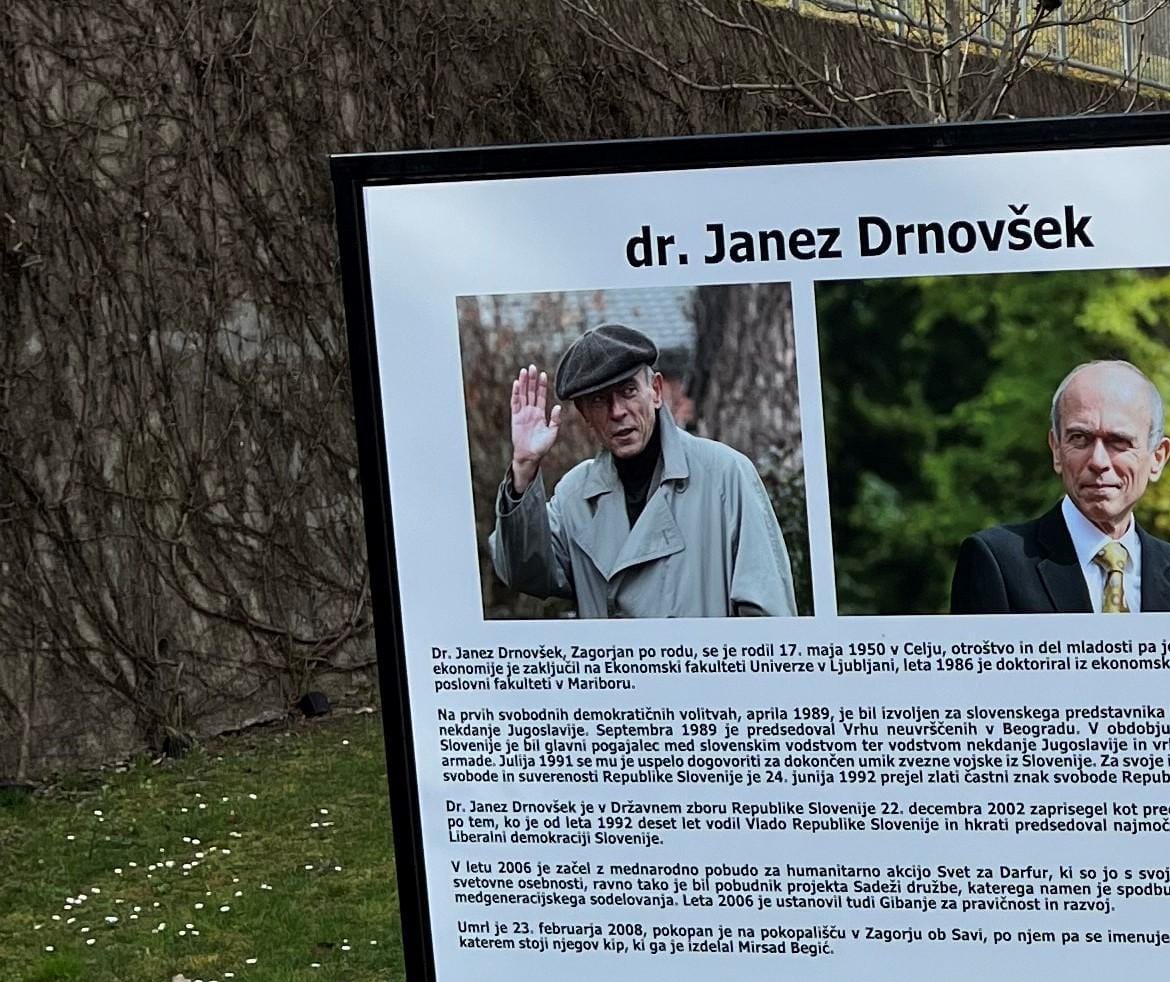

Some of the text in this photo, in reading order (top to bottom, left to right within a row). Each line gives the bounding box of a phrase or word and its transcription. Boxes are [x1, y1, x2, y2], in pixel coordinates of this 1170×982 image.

[626, 204, 1096, 268] dr. Janez Drnovšek
[431, 646, 451, 659] Dr.
[455, 645, 494, 659] Janez
[498, 644, 566, 661] Drnovšek,
[570, 644, 634, 661] Zagorjan
[638, 647, 656, 661] po
[660, 644, 698, 659] rodu,
[702, 647, 719, 657] se
[720, 643, 737, 660] je
[741, 643, 774, 656] rodil
[779, 643, 802, 656] 17.
[806, 642, 843, 659] maja
[848, 642, 885, 655] 1950
[889, 645, 899, 655] v
[903, 641, 946, 658] Celju,
[950, 640, 1015, 654] otroštvo
[1019, 640, 1033, 654] in
[1038, 640, 1061, 653] del
[1066, 639, 1132, 653] mladosti
[1137, 642, 1156, 656] pa
[432, 661, 504, 678] ekonomije
[505, 661, 520, 677] je
[522, 660, 580, 677] zaključil
[583, 663, 601, 673] na
[604, 660, 681, 673] Ekonomski
[684, 659, 746, 673] fakulteti
[749, 659, 814, 672] Univerze
[816, 662, 826, 672] v
[830, 658, 899, 675] Ljubljani,
[903, 658, 931, 671] leta
[936, 657, 974, 671] 1986
[975, 657, 992, 674] je
[995, 656, 1070, 670] doktoriral
[1074, 656, 1088, 669] iz
[434, 676, 635, 693] poslovni fakulteti v Mariboru.
[438, 723, 501, 739] nekdanje
[507, 723, 589, 739] Jugoslavije.
[596, 722, 673, 739] Septembra
[681, 722, 717, 736] 1989
[723, 722, 739, 739] je
[746, 722, 835, 739] predsedoval
[843, 722, 879, 735] Vrhu
[886, 721, 977, 735] neuvrščenih
[985, 725, 995, 735] v
[1002, 721, 1080, 738] Beogradu.
[1088, 721, 1098, 734] V
[1106, 721, 1170, 737] obdobju
[440, 738, 502, 754] Slovenije
[504, 738, 519, 754] je
[523, 738, 541, 751] bil
[544, 738, 587, 754] glavni
[591, 738, 660, 754] pogajalec
[664, 738, 695, 751] med
[699, 738, 781, 751] slovenskim
[783, 738, 857, 751] vodstvom
[861, 739, 884, 751] ter
[887, 738, 961, 751] vodstvom
[966, 738, 1037, 754] nekdanje
[1041, 737, 1128, 754] Jugoslavije
[1133, 737, 1147, 750] in
[442, 769, 499, 782] svobode
[502, 769, 515, 782] in
[518, 769, 598, 782] suverenosti
[602, 769, 673, 785] Republike
[676, 769, 743, 786] Slovenije
[745, 770, 761, 786] je
[765, 770, 788, 782] 24.
[790, 770, 834, 786] junija
[839, 770, 876, 783] 1992
[879, 770, 923, 786] prejel
[927, 770, 959, 783] zlati
[963, 769, 1009, 783] častni
[1012, 770, 1051, 783] znak
[1052, 770, 1117, 783] svobode
[446, 799, 465, 812] Dr.
[469, 800, 508, 812] Janez
[512, 799, 576, 813] Drnovšek
[578, 800, 594, 816] je
[597, 803, 606, 813] v
[610, 800, 682, 813] Državnem
[685, 801, 727, 813] zboru
[731, 801, 804, 817] Republike
[808, 801, 877, 817] Slovenije
[880, 802, 904, 814] 22.
[908, 802, 982, 815] decembra
[987, 802, 1025, 815] 2002
[1029, 802, 1107, 818] zaprisegel
[1112, 802, 1139, 815] kot
[448, 830, 663, 847] Liberalni demokraciji Slovenije.
[454, 890, 1115, 914] medgeneracijskega sodelovanja. Leta 2006 je ustanovil tudi Gibanje za pravičnost in razvoj.
[459, 935, 834, 957] katerem stoji njegov kip, ki ga je izdelal Mirsad Begić.
